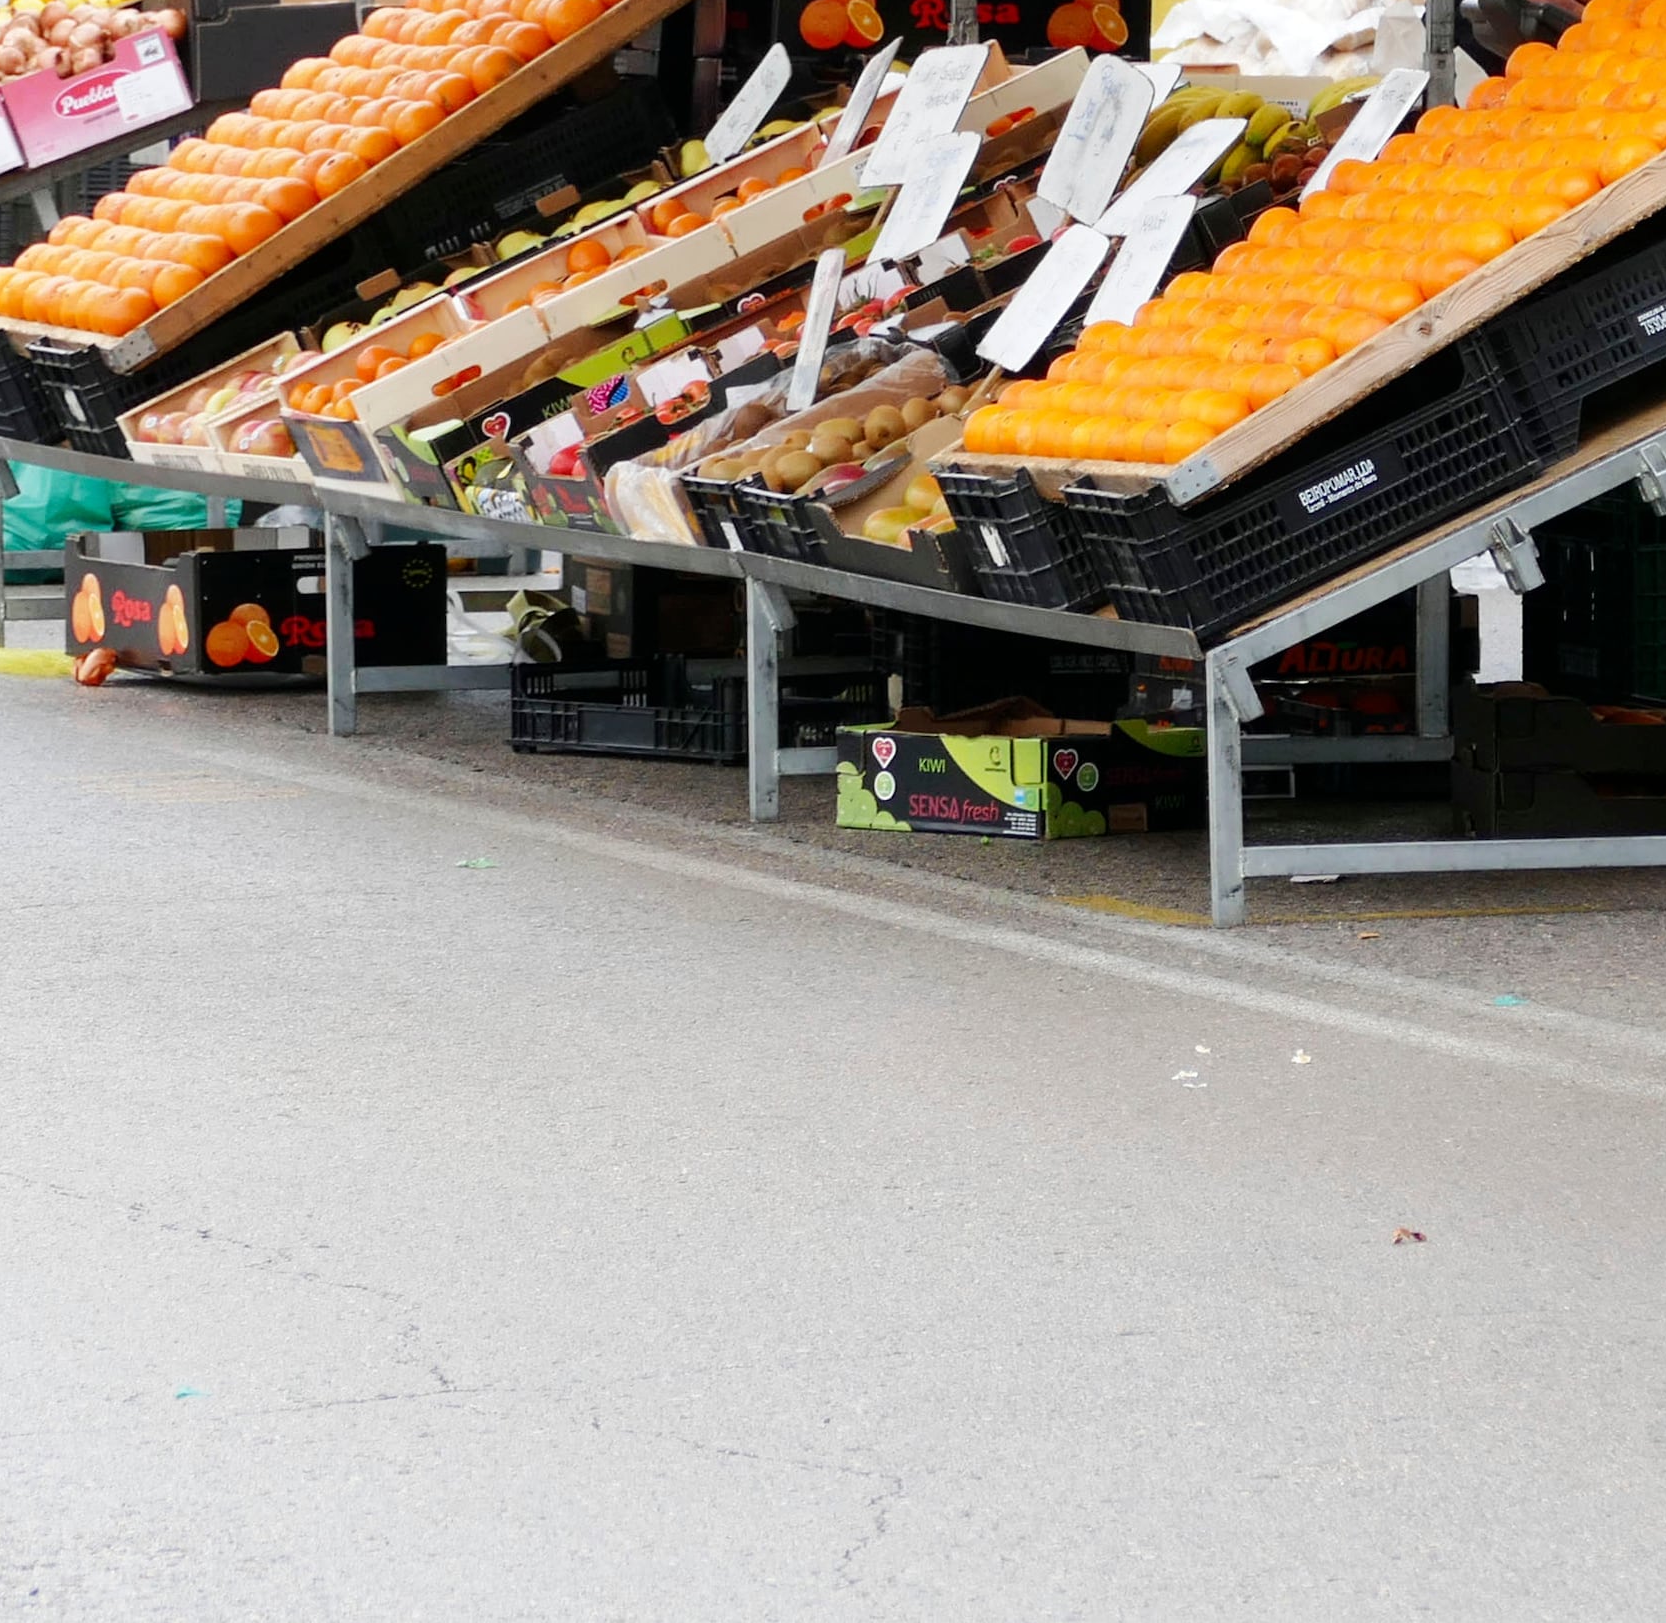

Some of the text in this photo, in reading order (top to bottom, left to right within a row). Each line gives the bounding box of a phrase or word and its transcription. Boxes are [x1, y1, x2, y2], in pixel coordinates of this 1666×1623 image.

[110, 589, 152, 627] Rosa
[281, 615, 375, 647] Roa
[1277, 641, 1411, 676] ALTURA
[918, 757, 946, 774] KIWI
[908, 793, 961, 819] SENSA
[959, 798, 1000, 825] fresh
